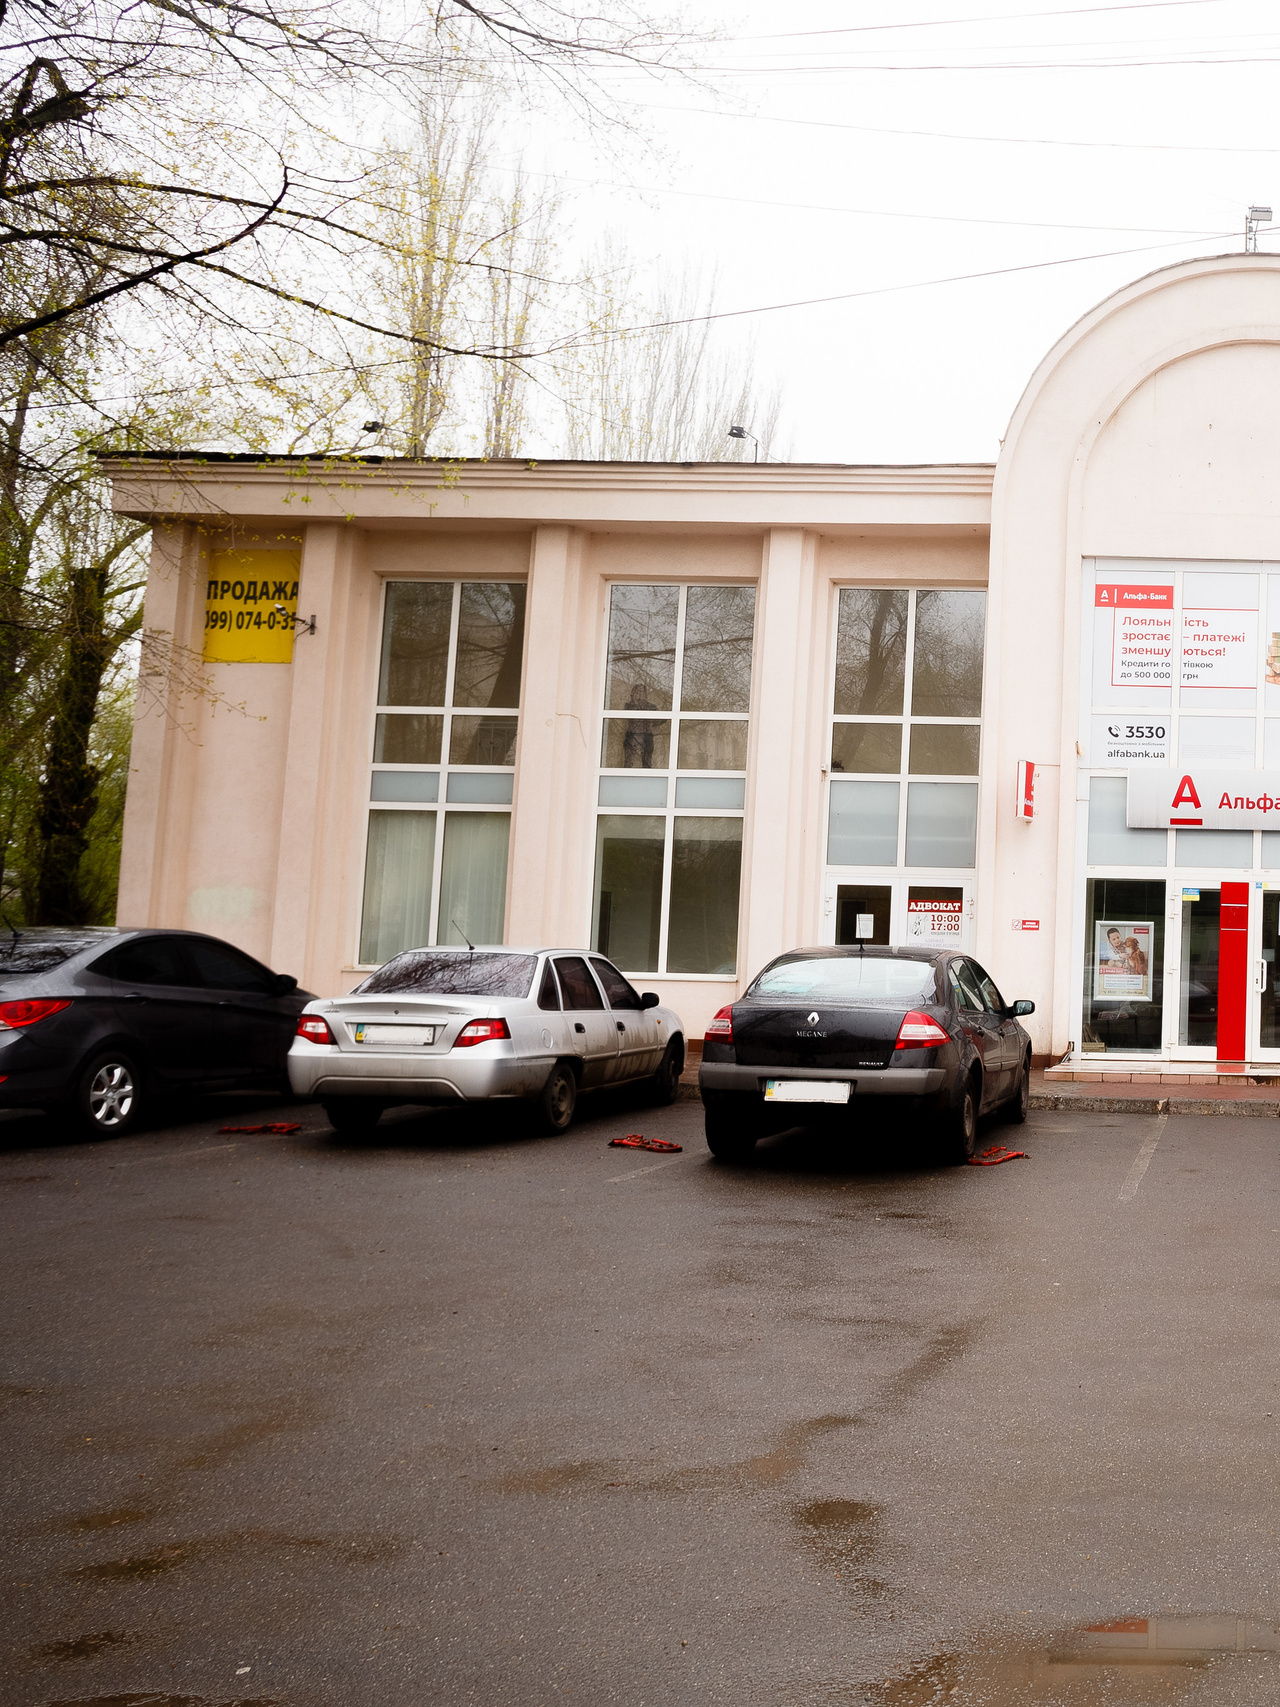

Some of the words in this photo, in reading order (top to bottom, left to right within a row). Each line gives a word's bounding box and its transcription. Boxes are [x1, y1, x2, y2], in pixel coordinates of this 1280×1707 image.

[207, 580, 299, 605] ПРОДАЖА
[1122, 631, 1171, 642] зростає
[1193, 632, 1246, 643] платежі
[1121, 659, 1159, 669] Кредити
[1134, 671, 1151, 679] 500
[1153, 671, 1171, 679] 000
[1182, 673, 1199, 681] грн
[1125, 725, 1166, 739] 3530
[1107, 749, 1166, 759] alfabank.ua
[909, 901, 961, 912] АДВОКАТ
[931, 914, 960, 922] 10:00
[931, 923, 960, 931] 17:00
